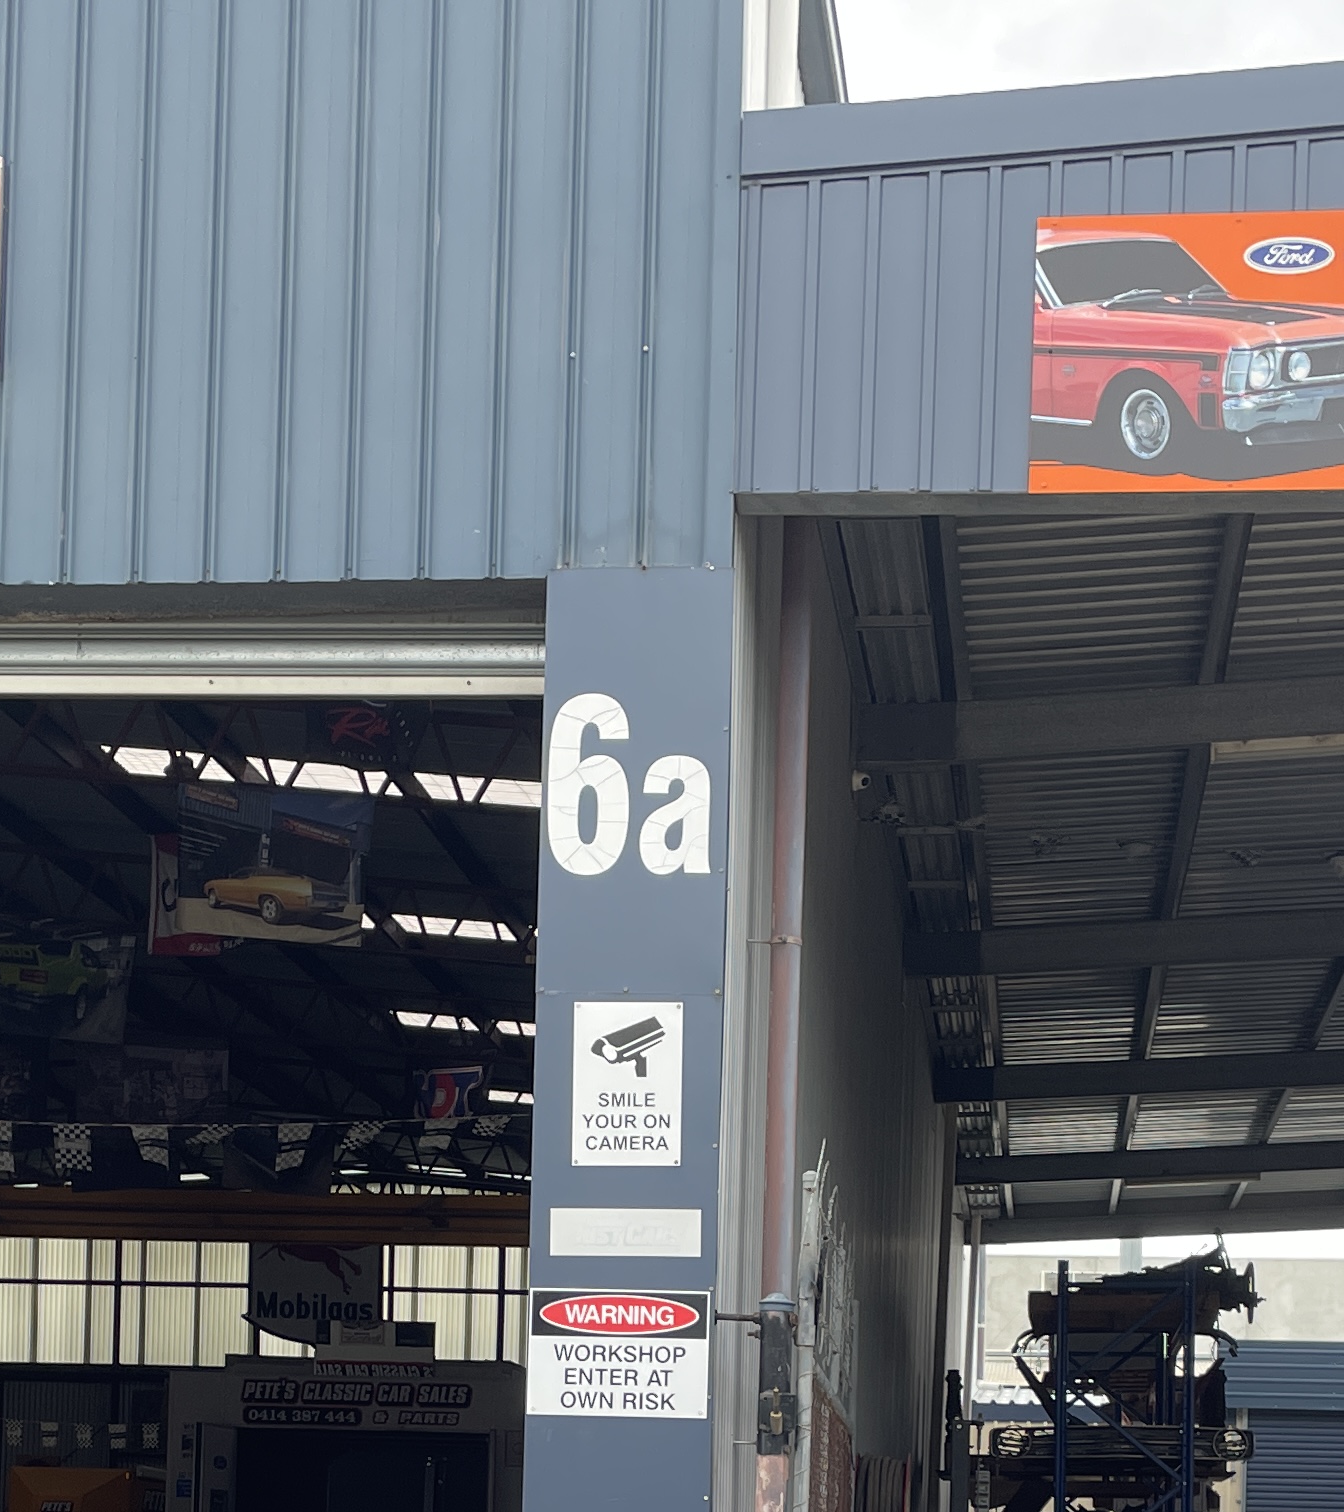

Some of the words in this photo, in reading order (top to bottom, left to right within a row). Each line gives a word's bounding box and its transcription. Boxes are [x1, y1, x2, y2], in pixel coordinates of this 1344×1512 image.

[1263, 244, 1315, 265] Ford
[547, 692, 711, 876] 6a
[598, 1092, 656, 1108] SMILE
[582, 1114, 638, 1129] YOUR
[643, 1114, 671, 1129] ON
[585, 1135, 669, 1151] CAMERA
[565, 1302, 675, 1326] WARNING
[554, 1344, 686, 1363] WORKSHOP
[564, 1367, 638, 1386] ENTER
[647, 1369, 673, 1387] AT
[243, 1379, 297, 1401] PETE'S
[303, 1382, 373, 1403] CLASSIC
[377, 1383, 413, 1404] CAR
[418, 1384, 470, 1405] SALES
[560, 1391, 614, 1409] OWN
[623, 1393, 676, 1411] RISK
[247, 1409, 287, 1422] 0414
[292, 1410, 321, 1422] 387
[324, 1410, 357, 1423] 444
[398, 1411, 459, 1425] PARTS
